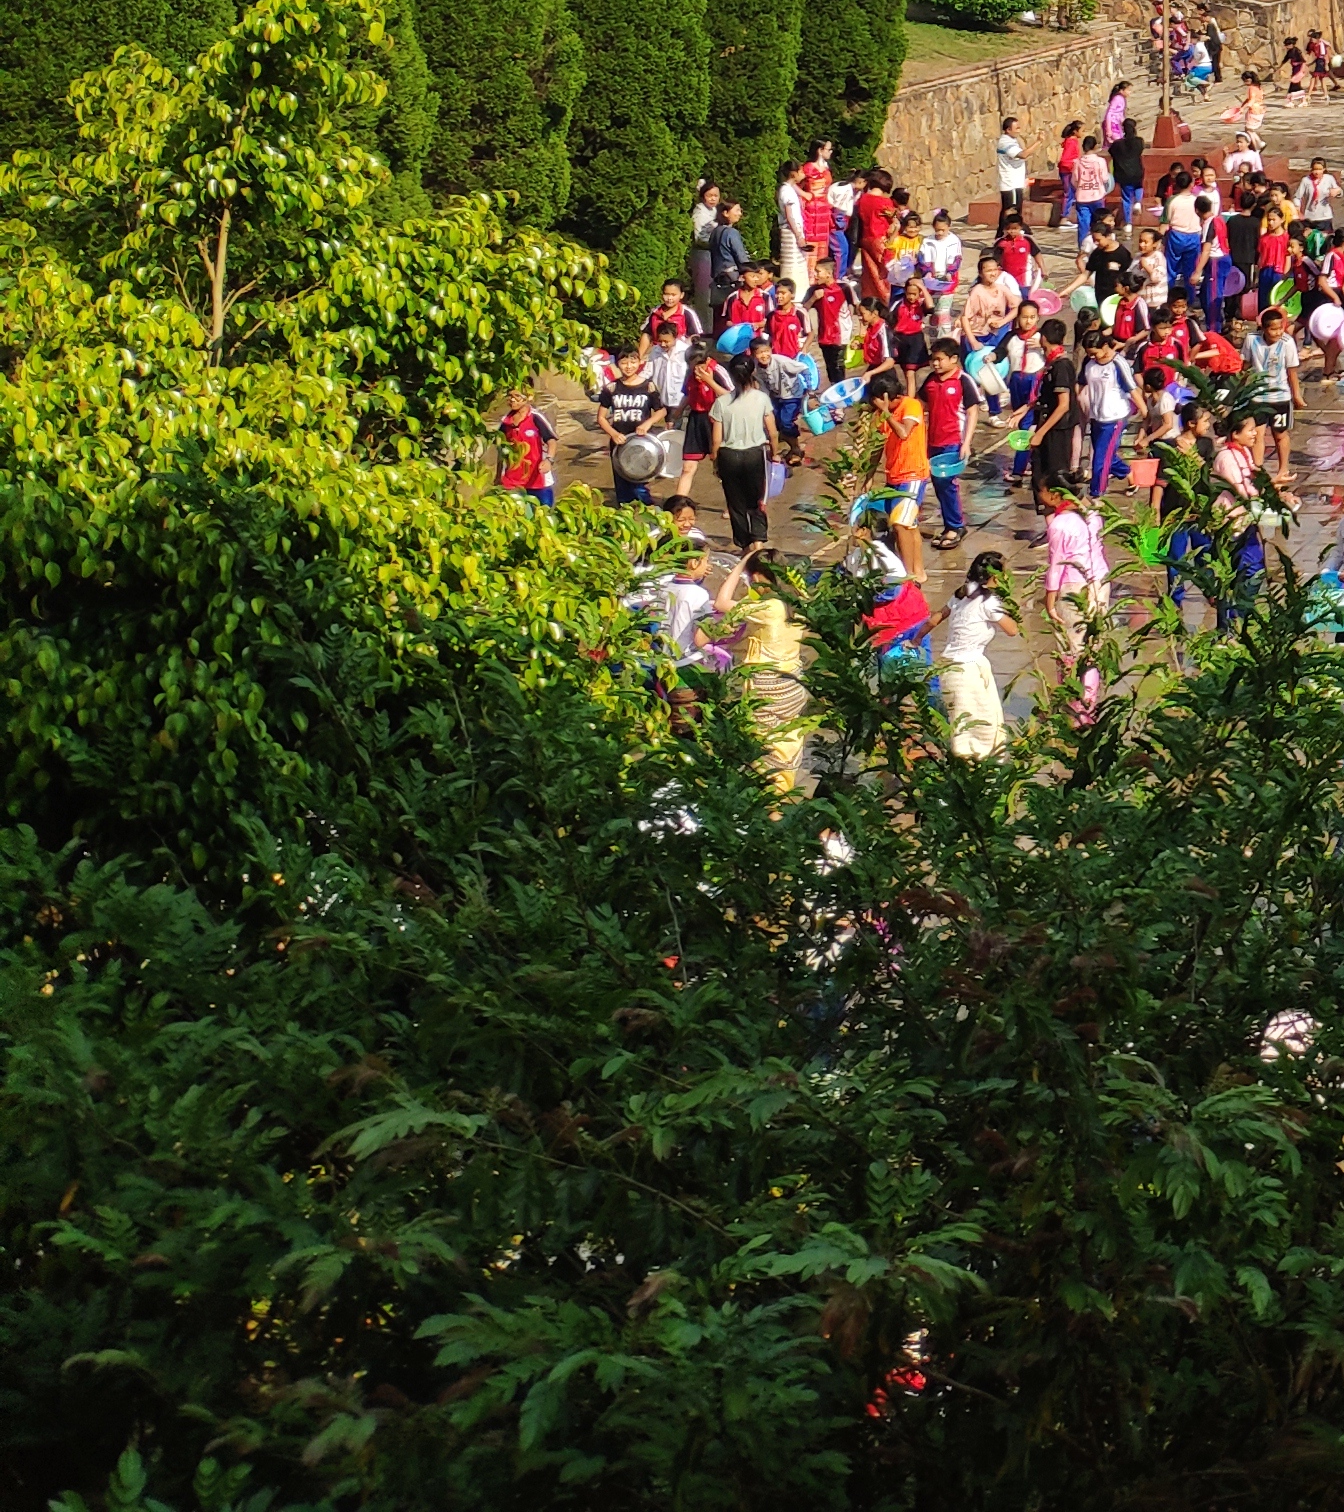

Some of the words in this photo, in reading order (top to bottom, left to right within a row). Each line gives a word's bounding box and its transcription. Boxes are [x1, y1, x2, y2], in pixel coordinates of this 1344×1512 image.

[612, 394, 648, 408] WHAT
[613, 409, 643, 422] EVER
[1273, 413, 1287, 427] 21
